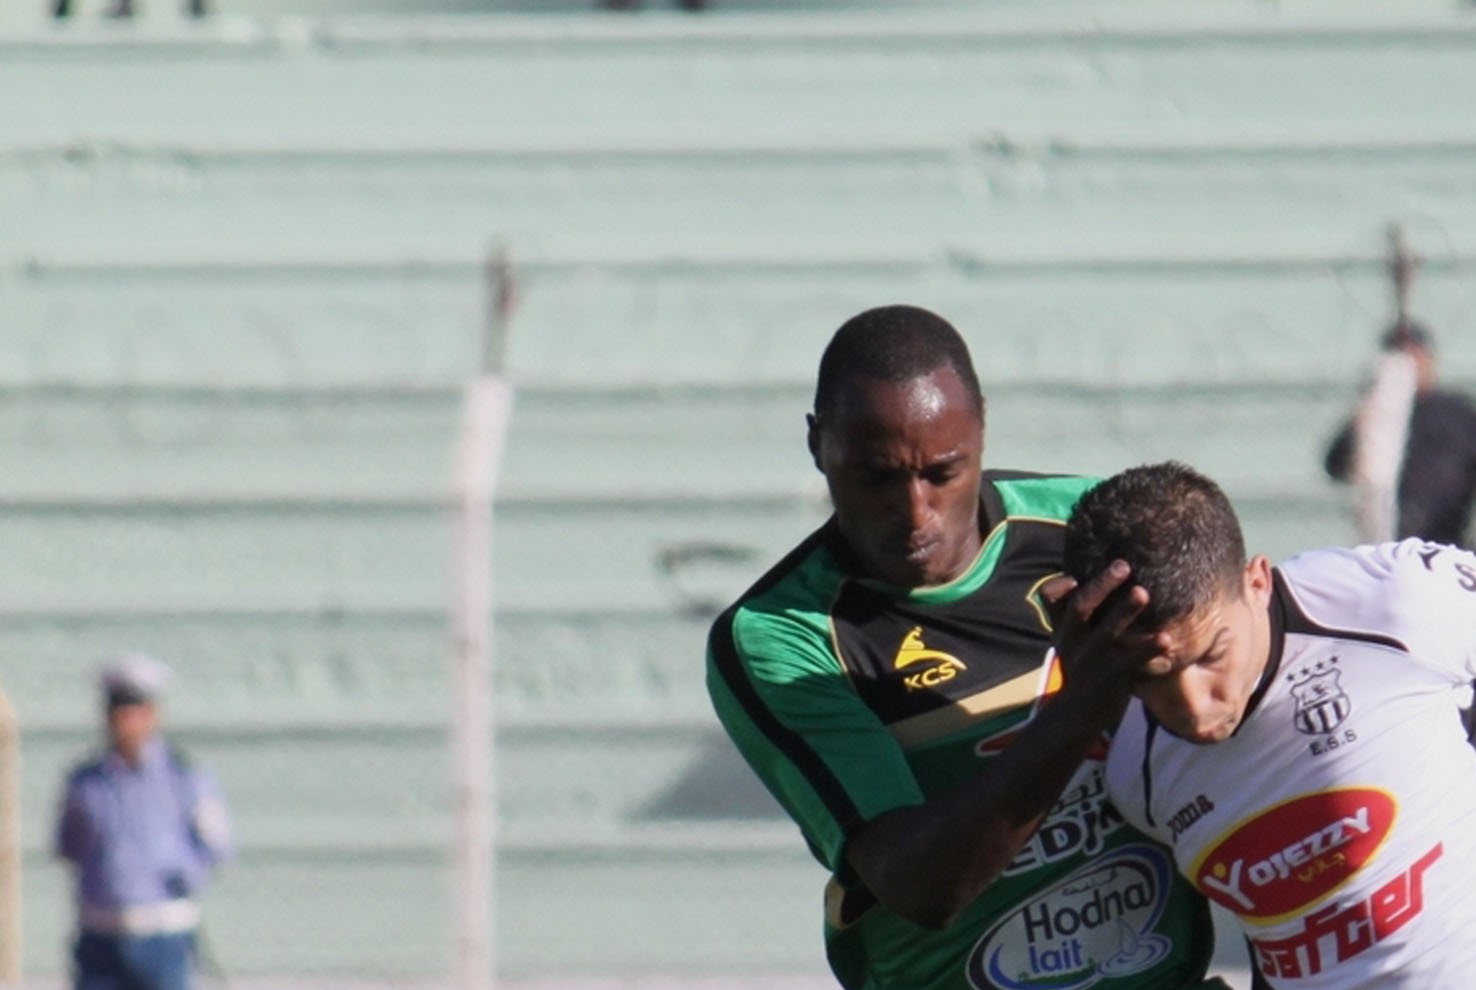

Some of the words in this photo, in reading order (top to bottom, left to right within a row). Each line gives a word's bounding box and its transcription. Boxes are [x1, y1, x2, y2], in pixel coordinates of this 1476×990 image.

[904, 661, 957, 691] KCS
[1022, 881, 1152, 944] Hodna
[1029, 938, 1084, 975] lait
